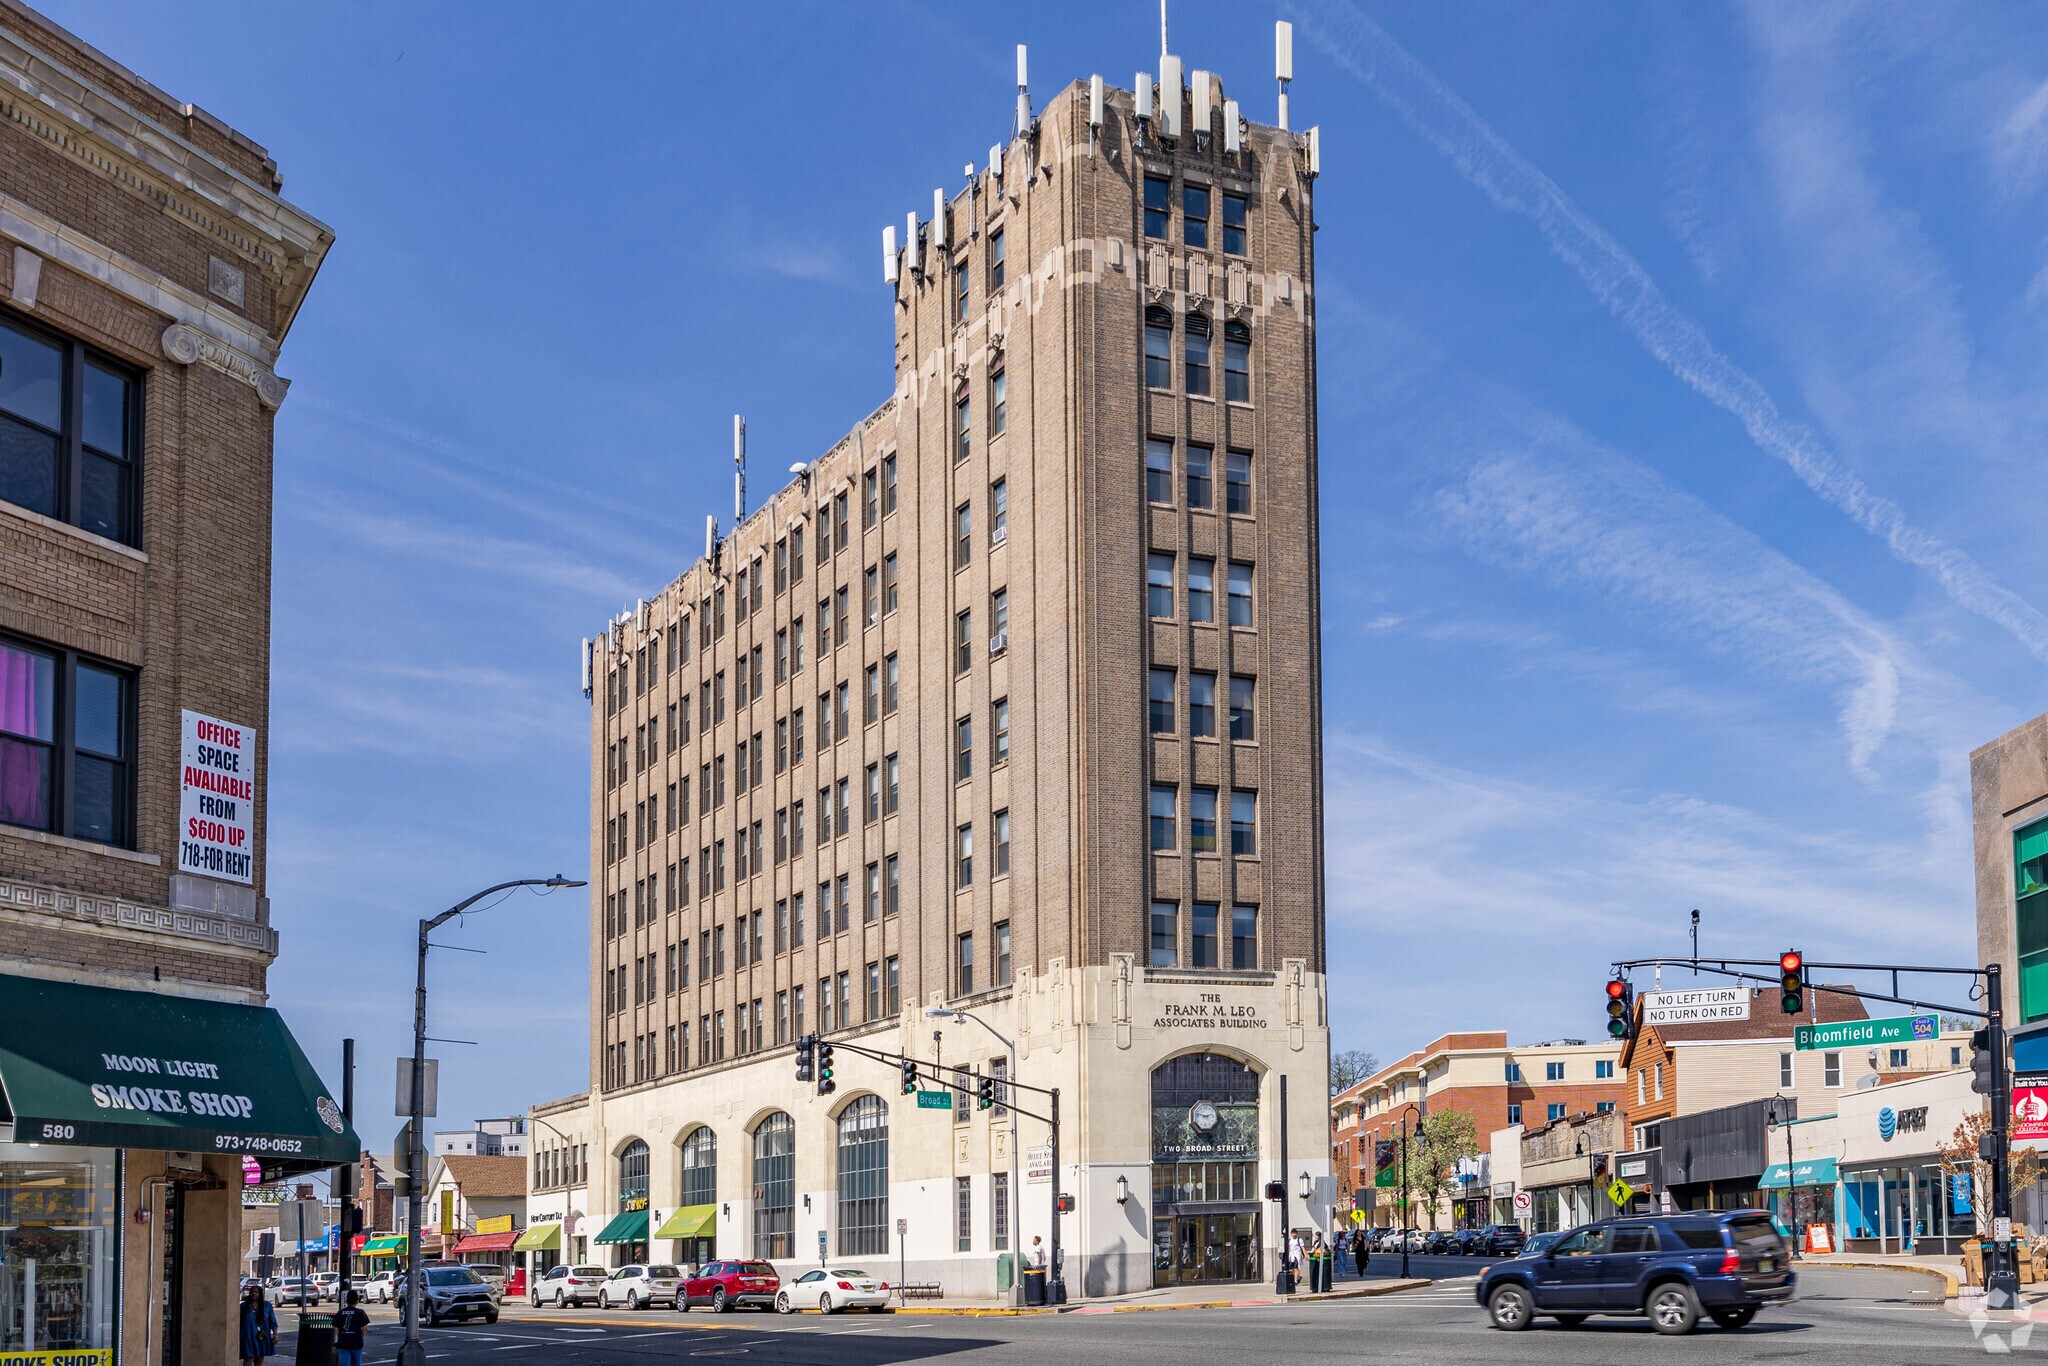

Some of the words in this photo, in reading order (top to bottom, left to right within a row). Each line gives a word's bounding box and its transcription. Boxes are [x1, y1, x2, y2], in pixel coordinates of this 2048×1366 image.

[197, 719, 241, 750] OFFICE
[197, 745, 239, 773] SPACE
[183, 765, 252, 801] AVALIABLE
[199, 795, 236, 821] FROM
[188, 816, 225, 844] $600
[228, 826, 245, 847] UP
[181, 841, 223, 872] 718-FOR
[225, 851, 251, 878] RENT
[1200, 993, 1221, 1003] THE
[1658, 995, 1673, 1005] NO
[1676, 993, 1703, 1004] LEFT
[1705, 991, 1736, 1002] TURN
[1165, 1004, 1208, 1016] FRANK
[1212, 1005, 1227, 1016] M.
[1230, 1006, 1256, 1017] LEO
[1650, 1011, 1665, 1020] NO
[1669, 1009, 1698, 1019] TURN
[1701, 1007, 1717, 1017] ON
[1720, 1006, 1743, 1016] RED
[1153, 1018, 1216, 1028] ASSOCIATES
[1219, 1019, 1267, 1028] BUILDING
[1914, 1024, 1932, 1034] 504
[1800, 1025, 1873, 1044] Bloomfield
[1880, 1027, 1900, 1038] Ave
[102, 1053, 160, 1074] MOON
[164, 1060, 219, 1080] LIGHT
[91, 1083, 188, 1114] SMOKE
[189, 1091, 253, 1118] SHOP
[919, 1094, 941, 1105] Broad
[1896, 1106, 1929, 1132] AT&T
[42, 1123, 75, 1140] 580
[1216, 1144, 1245, 1152] STREET
[0, 1356, 46, 1366] MOKE
[52, 1354, 99, 1366] SHOP
